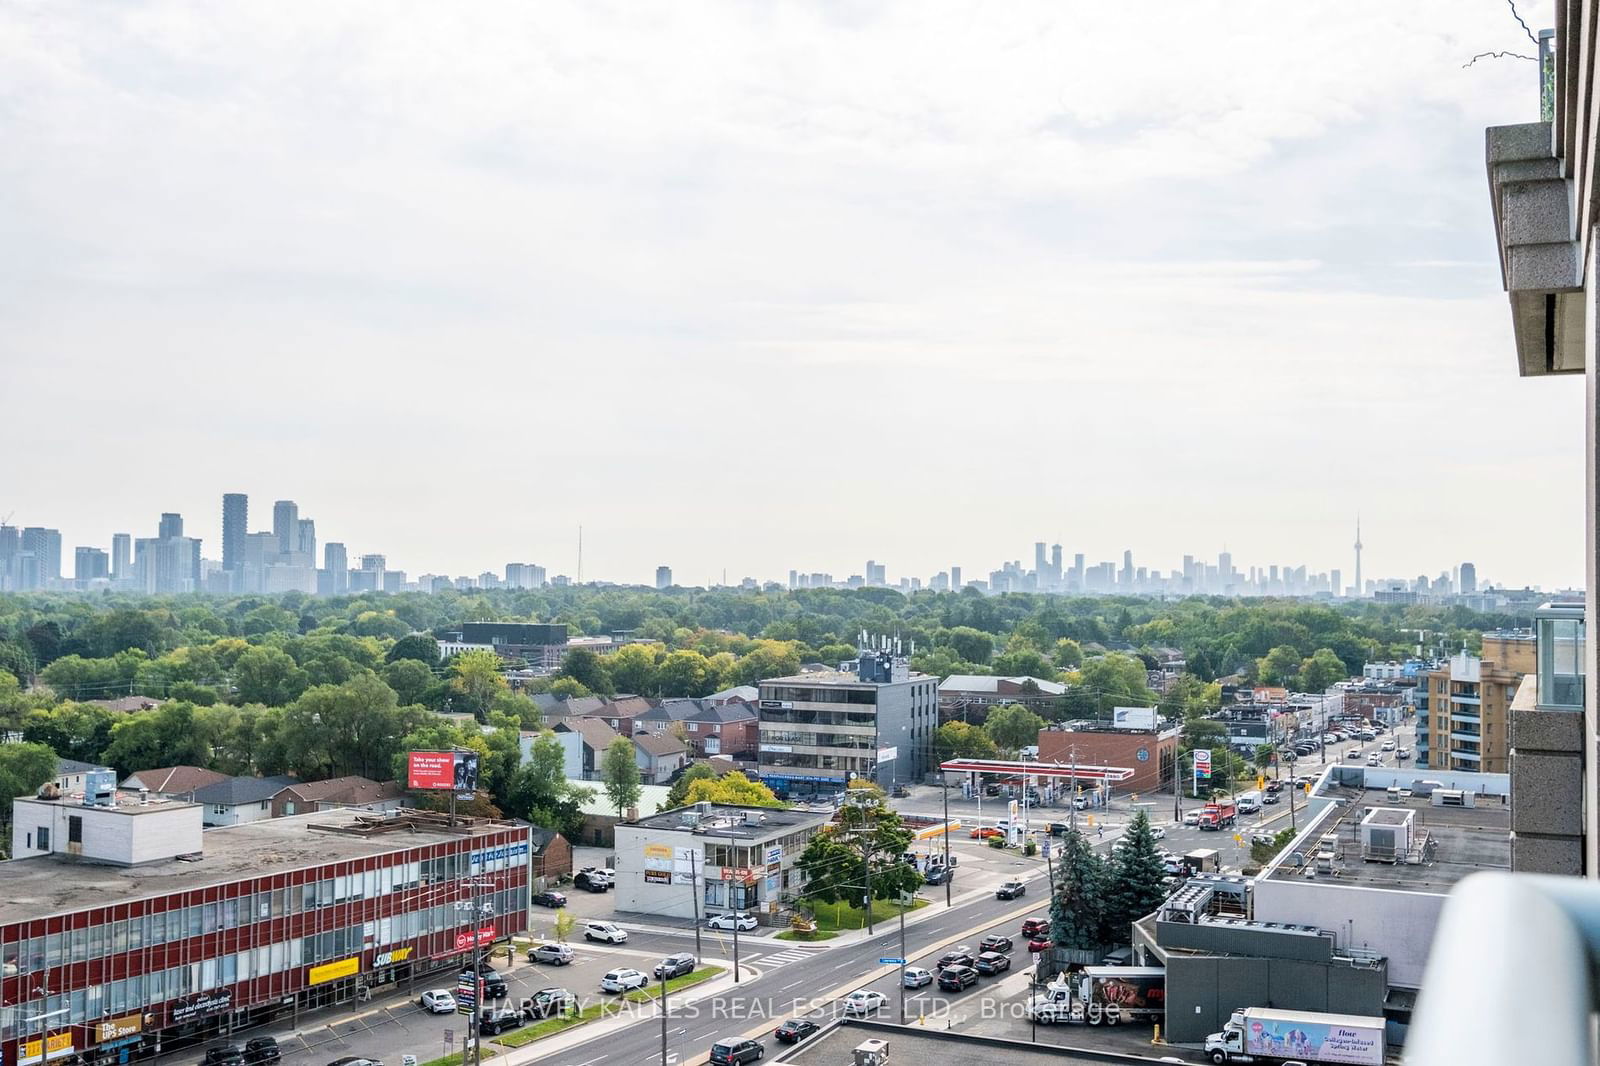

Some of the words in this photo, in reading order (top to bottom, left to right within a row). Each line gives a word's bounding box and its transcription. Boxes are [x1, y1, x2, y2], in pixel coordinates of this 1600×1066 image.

[373, 946, 413, 968] SUBWAY
[102, 1023, 116, 1031] The
[102, 1029, 118, 1040] UPS
[118, 1025, 136, 1037] Store
